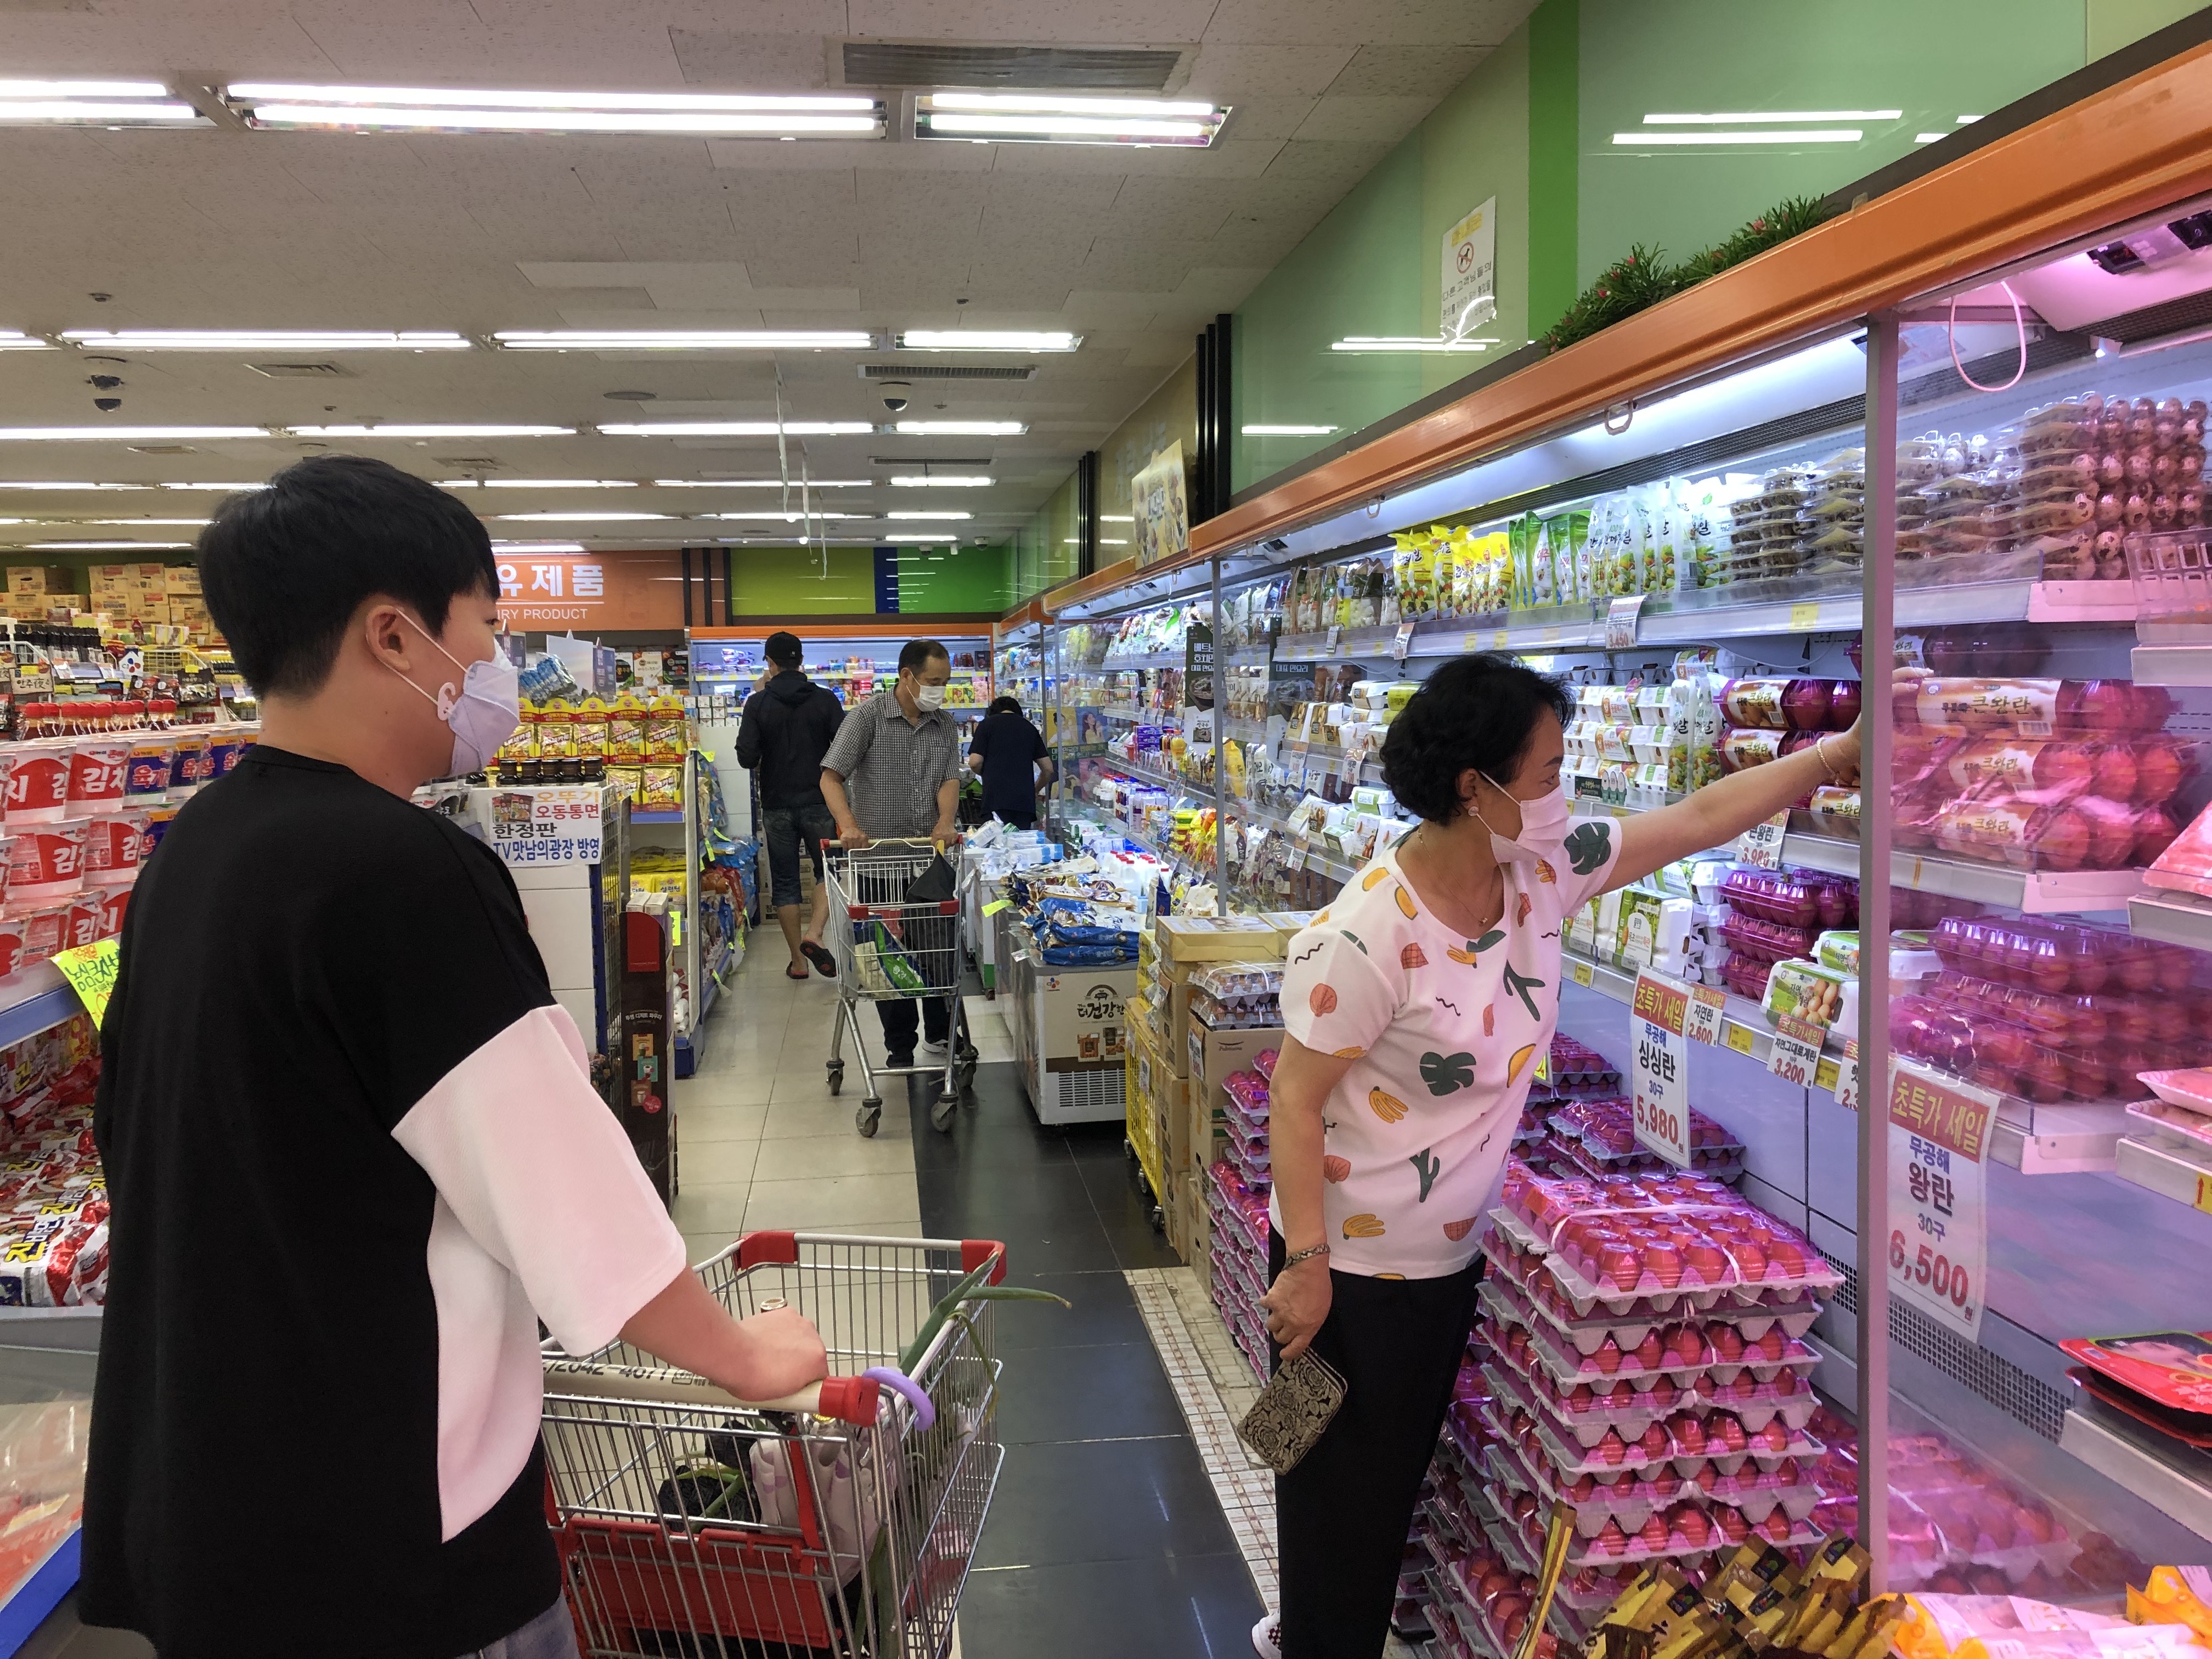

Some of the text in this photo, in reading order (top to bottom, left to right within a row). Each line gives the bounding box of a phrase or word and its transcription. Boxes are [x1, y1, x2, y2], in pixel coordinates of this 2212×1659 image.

[497, 564, 603, 597] 유제품
[497, 608, 588, 620] IRY PRODUCT
[1276, 664, 1288, 673] 대표
[133, 765, 171, 789] 육개
[535, 791, 599, 804] 오뚜기
[535, 804, 600, 820] 오동통면
[493, 822, 557, 839] 한정판
[577, 838, 600, 860] 방영
[1635, 984, 1685, 1032] 초특가 세일
[1645, 1023, 1667, 1048] 무공해
[1689, 1022, 1713, 1046] 2,600
[1639, 1040, 1675, 1083] 싱싱란
[1774, 1058, 1805, 1085] 3,200
[1649, 1080, 1663, 1100] 30구
[1637, 1094, 1678, 1145] 5,980
[1892, 1081, 1985, 1155] 초특가 세일
[1909, 1135, 1950, 1175] 무공해
[1909, 1162, 1955, 1218] 왕란
[1918, 1213, 1945, 1243] 30구
[1889, 1229, 1969, 1307] 6,500
